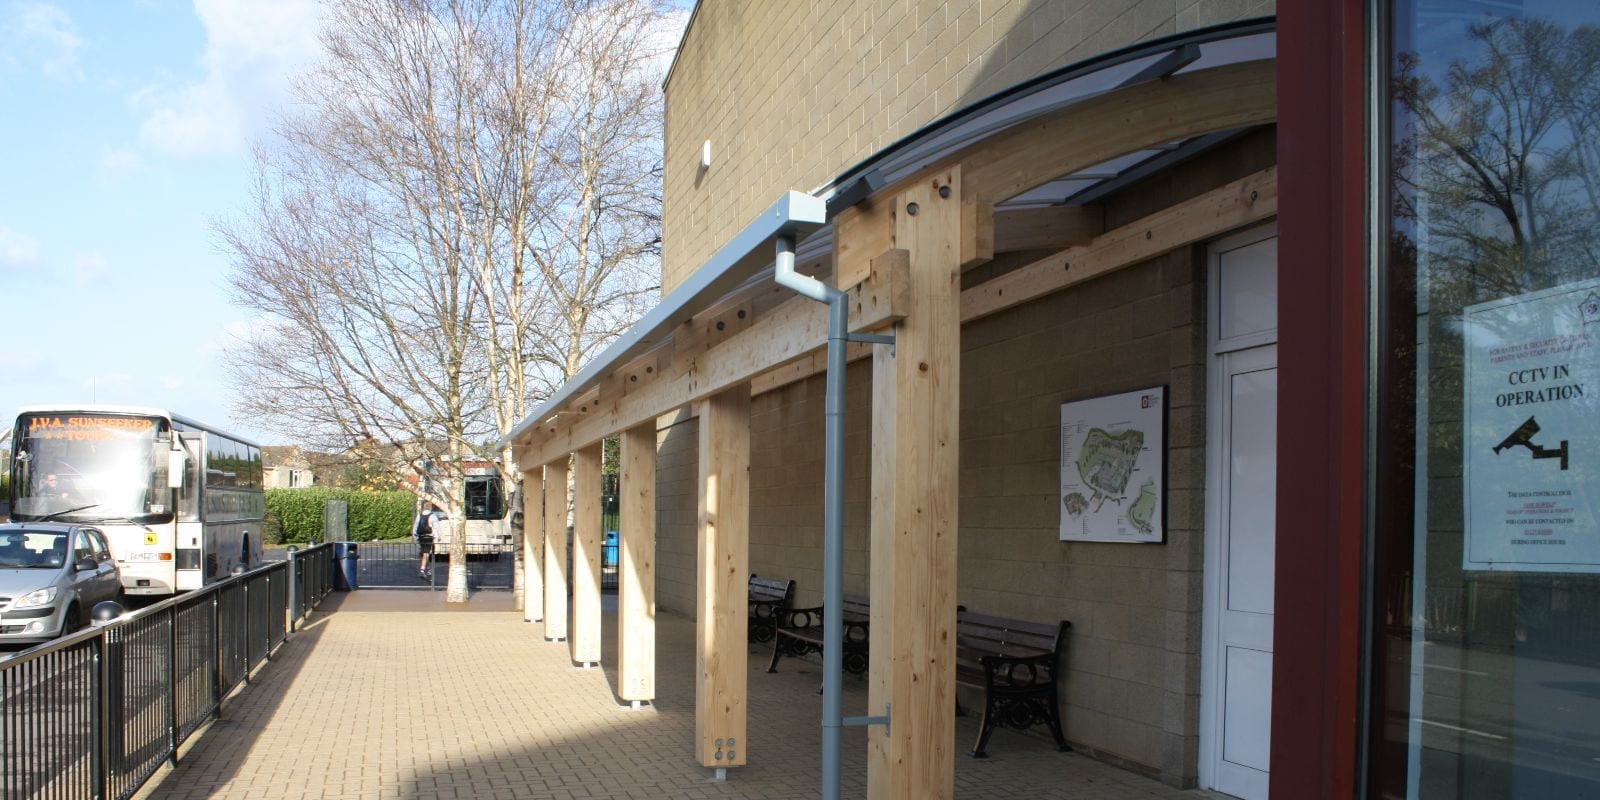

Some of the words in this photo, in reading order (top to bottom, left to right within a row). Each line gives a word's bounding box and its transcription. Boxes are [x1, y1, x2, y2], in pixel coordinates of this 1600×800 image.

[1508, 366, 1549, 385] CCTV
[1553, 364, 1569, 379] IN
[1496, 383, 1584, 407] OPERATION
[68, 417, 153, 431] SUNSEEKER
